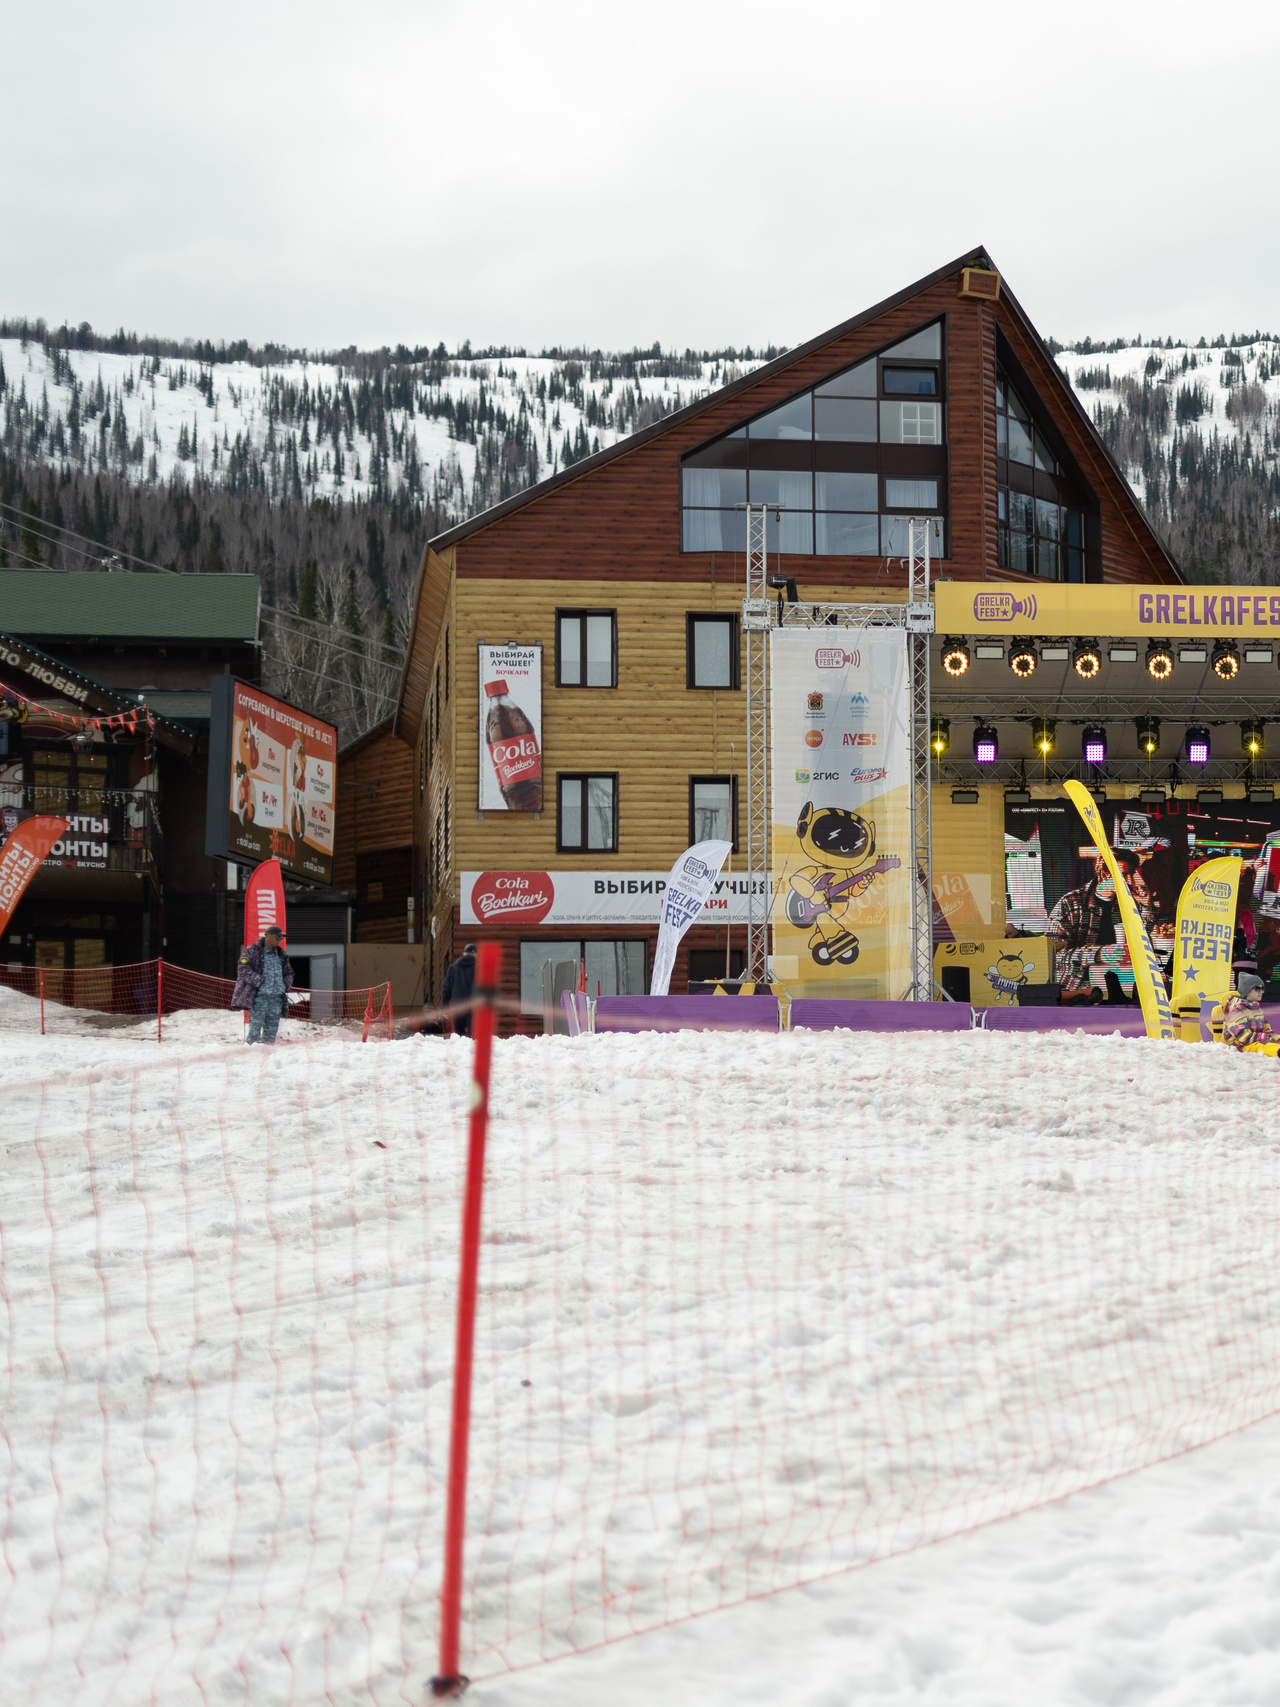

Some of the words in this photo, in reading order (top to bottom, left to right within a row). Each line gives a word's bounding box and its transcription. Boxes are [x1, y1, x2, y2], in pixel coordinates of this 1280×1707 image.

[979, 596, 1010, 607] GRELKA
[979, 607, 1000, 617] FEST
[489, 651, 535, 659] ВЫБИРАЙ
[24, 662, 89, 702] ЛЮБВИ
[238, 693, 270, 718] СОГРЕВАЕМ
[842, 733, 877, 746] AYS!
[492, 739, 537, 763] Cola
[813, 772, 840, 781] 2ГИС
[24, 858, 39, 880] ВКУСНО
[495, 877, 529, 889] Cola
[594, 880, 666, 894] ВЫБИР
[477, 890, 549, 918] Bochkari
[667, 887, 702, 915] GRELKA
